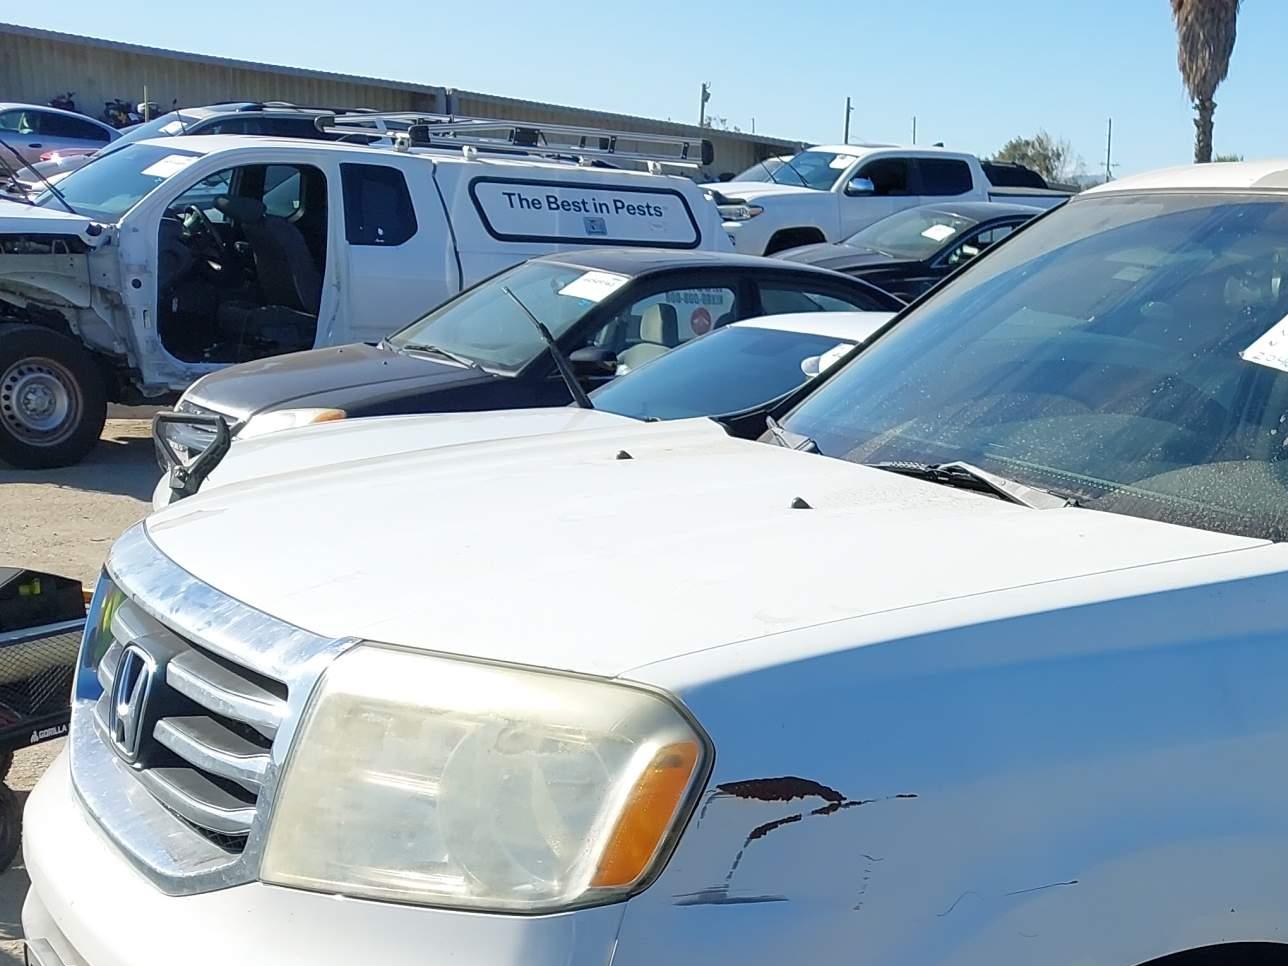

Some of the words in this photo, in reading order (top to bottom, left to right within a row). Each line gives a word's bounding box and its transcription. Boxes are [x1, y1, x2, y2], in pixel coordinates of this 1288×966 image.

[502, 192, 542, 210] The
[547, 195, 589, 213] Best
[592, 198, 610, 214] in
[615, 199, 663, 217] Pests
[39, 724, 68, 739] GORILLA
